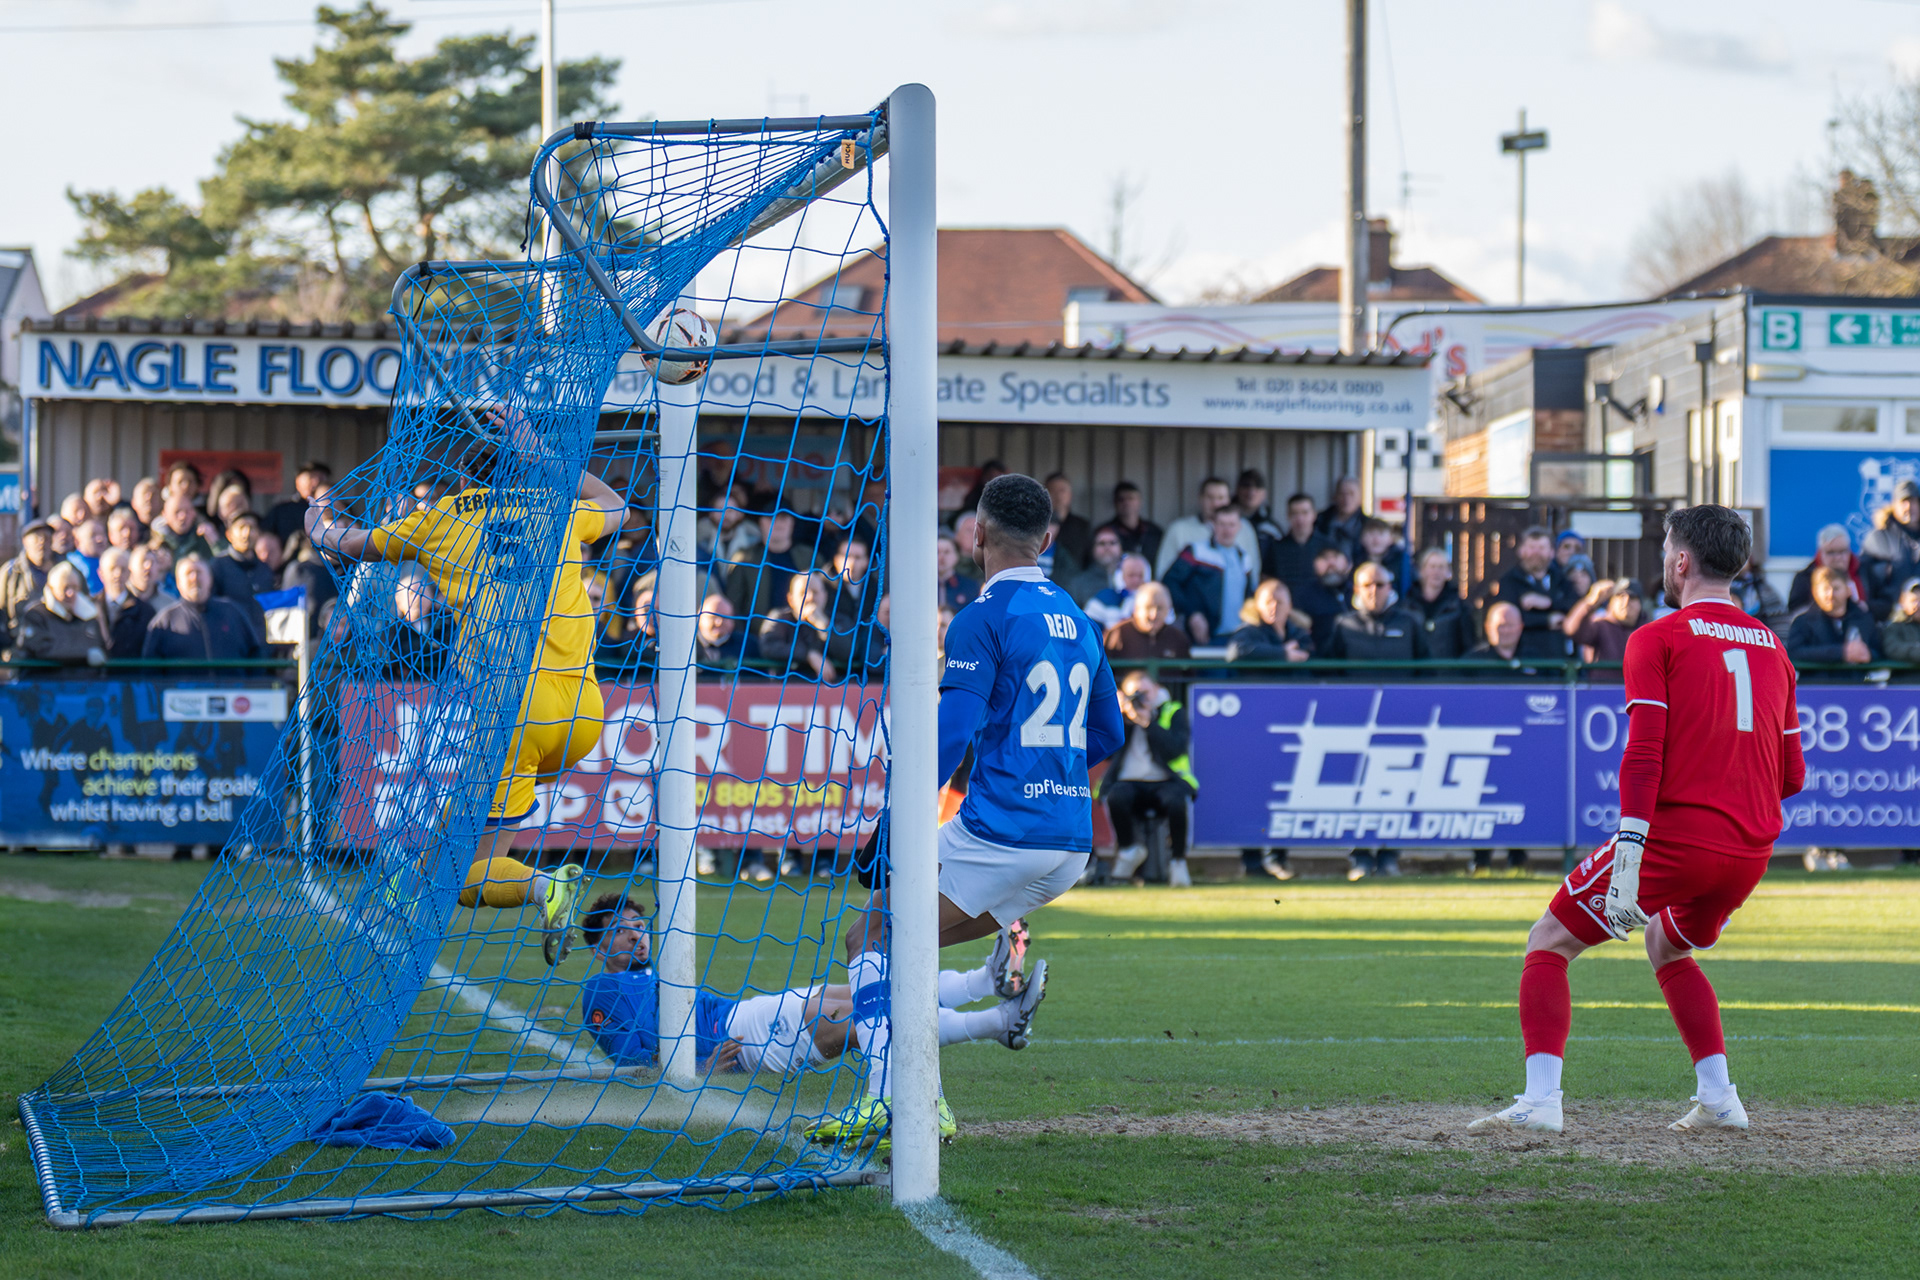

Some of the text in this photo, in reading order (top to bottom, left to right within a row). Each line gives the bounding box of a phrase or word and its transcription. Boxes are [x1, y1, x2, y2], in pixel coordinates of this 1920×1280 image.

[1766, 313, 1797, 348] B
[38, 339, 237, 393] NAGLE
[791, 371, 817, 399] &
[1000, 372, 1171, 411] Specialists
[1264, 377, 1293, 394] 020
[1042, 613, 1078, 640] REID
[1688, 618, 1777, 649] McDONNELL
[1020, 660, 1090, 750] 22
[1723, 648, 1753, 732] 1
[20, 748, 198, 774] Where champions
[82, 773, 260, 801] achieve their goals
[50, 798, 232, 828] whilst having a ball
[1267, 811, 1497, 840] SCAFFOLDING
